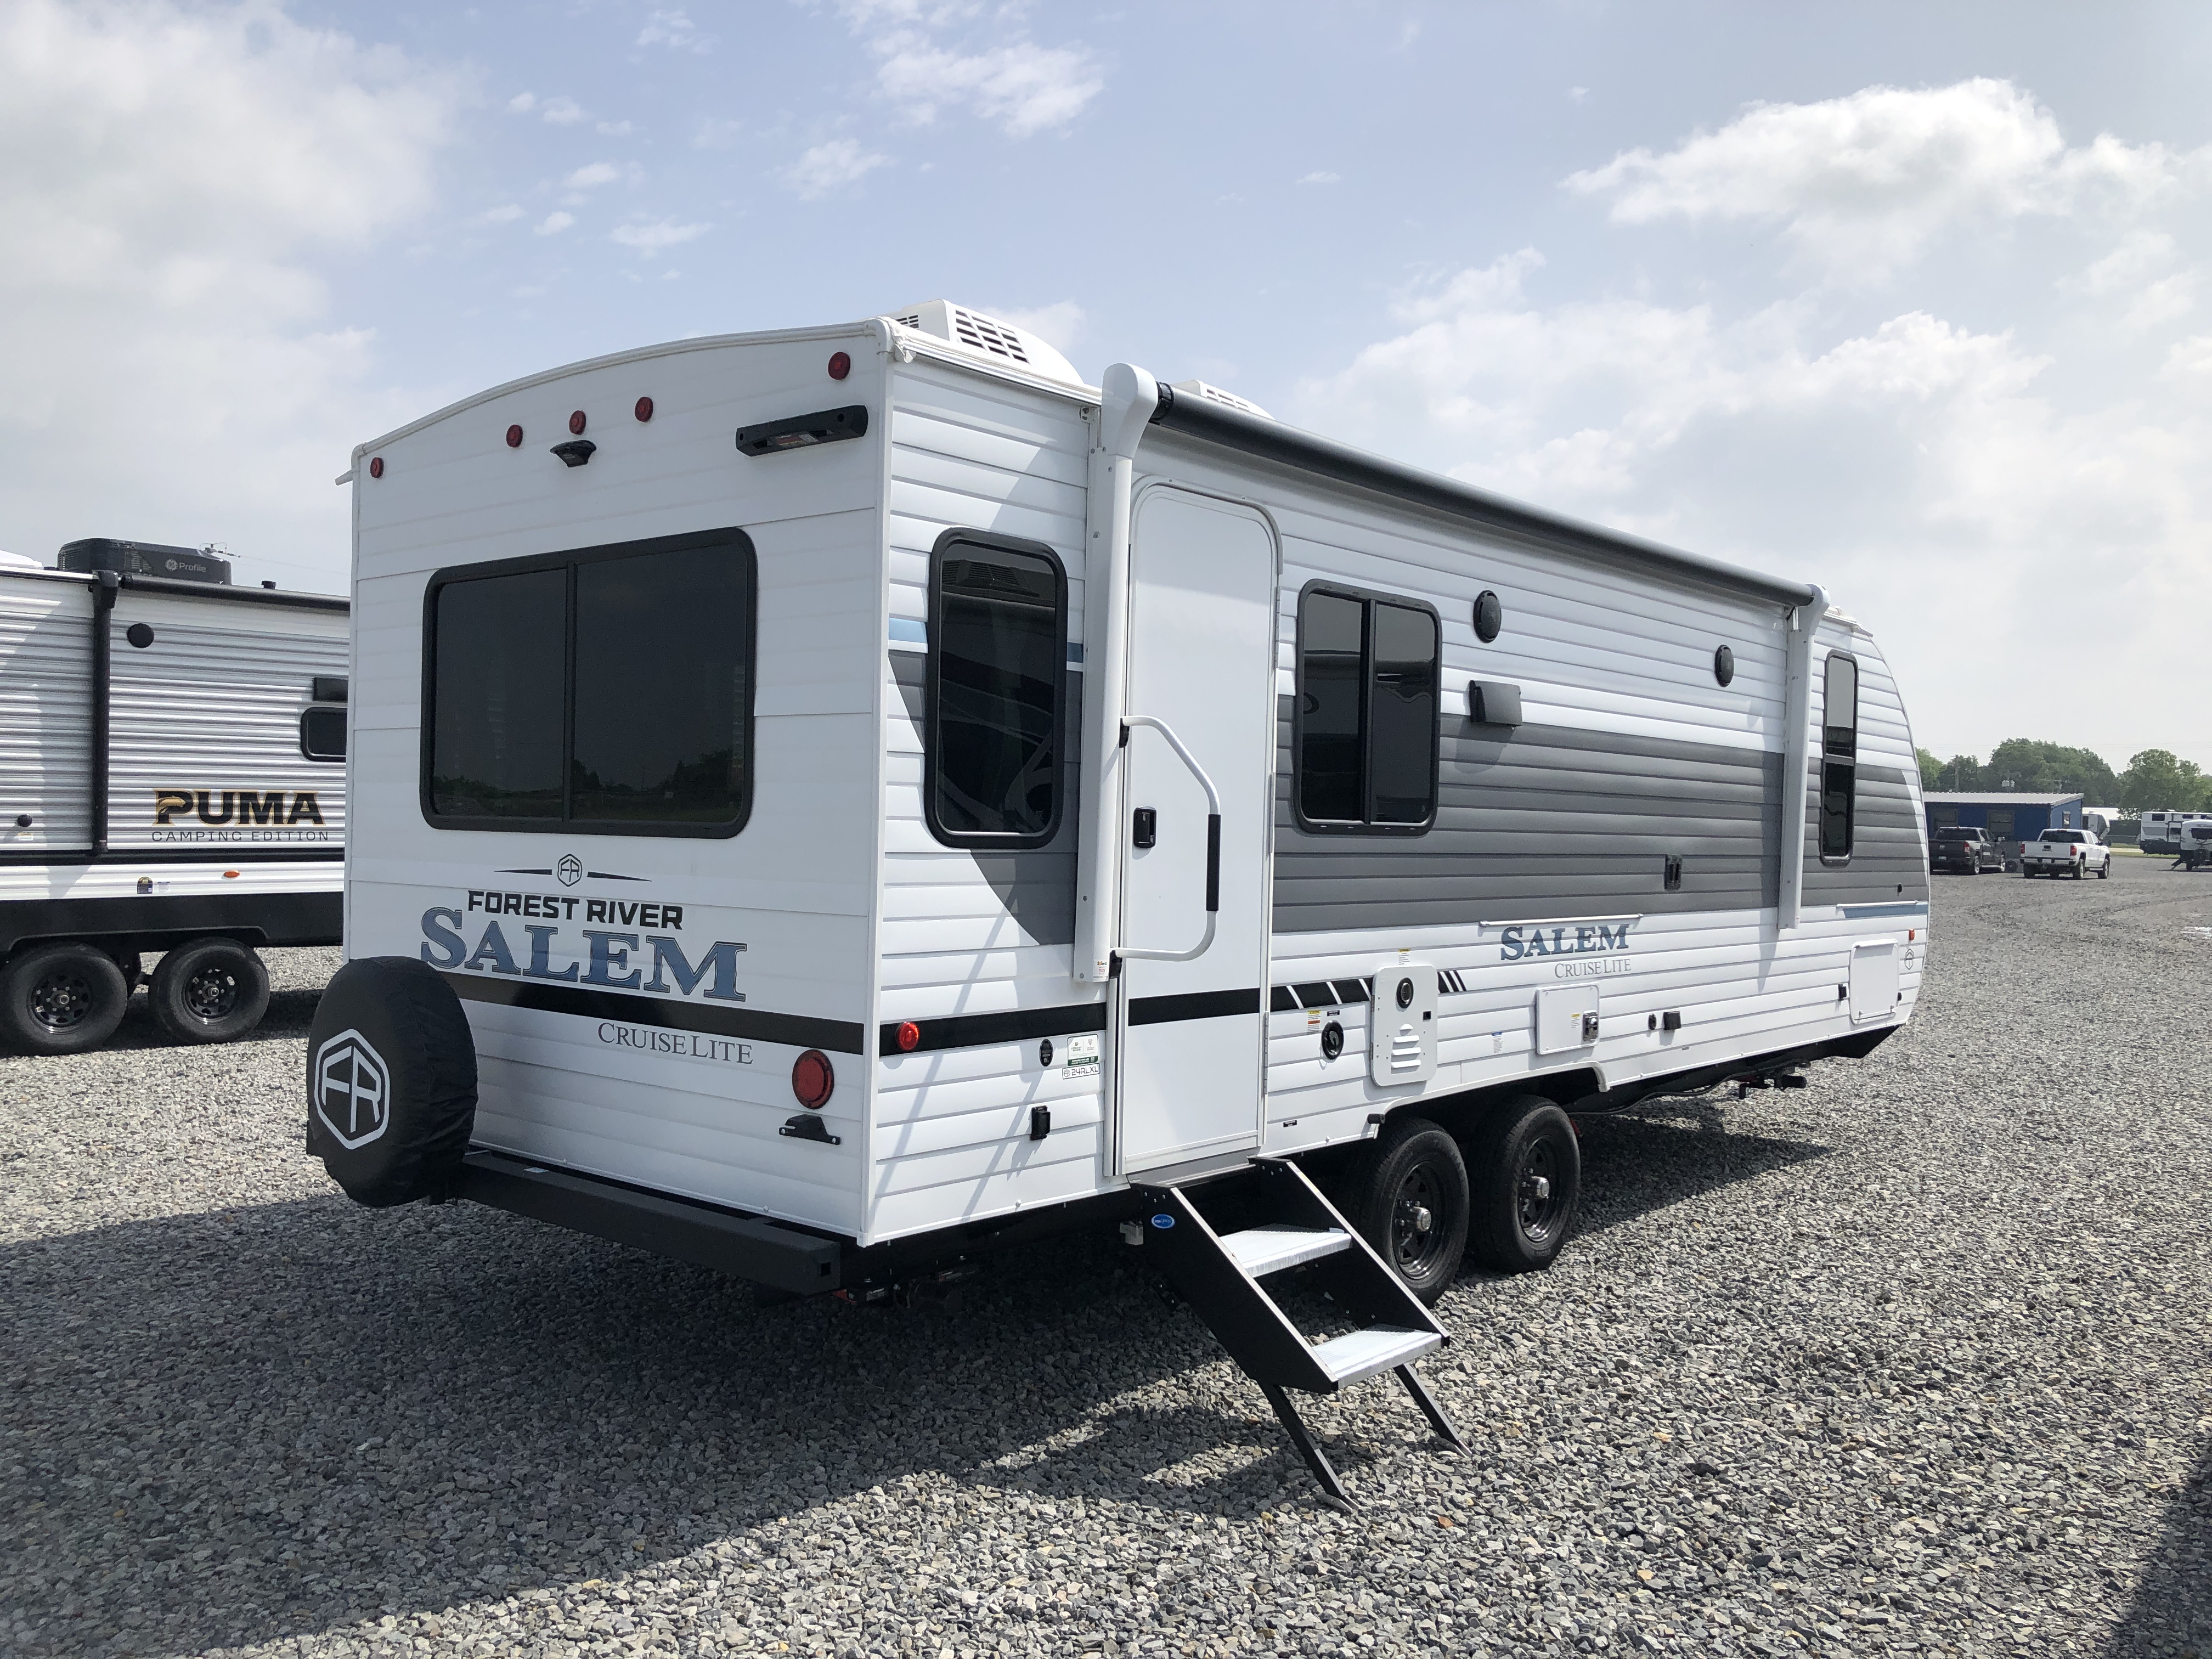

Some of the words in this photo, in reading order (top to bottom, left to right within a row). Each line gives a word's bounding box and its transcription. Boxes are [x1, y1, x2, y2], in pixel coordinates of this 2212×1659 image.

[179, 562, 207, 572] Profile
[152, 788, 326, 827] PUMA
[151, 831, 242, 842] CAMPING
[251, 831, 329, 842] EDITION
[468, 890, 580, 920] FOREST
[586, 899, 683, 930] RIVER
[420, 907, 747, 1002] SALEM
[1500, 924, 1629, 961] SALEM
[1071, 1065, 1099, 1076] 24RLXL
